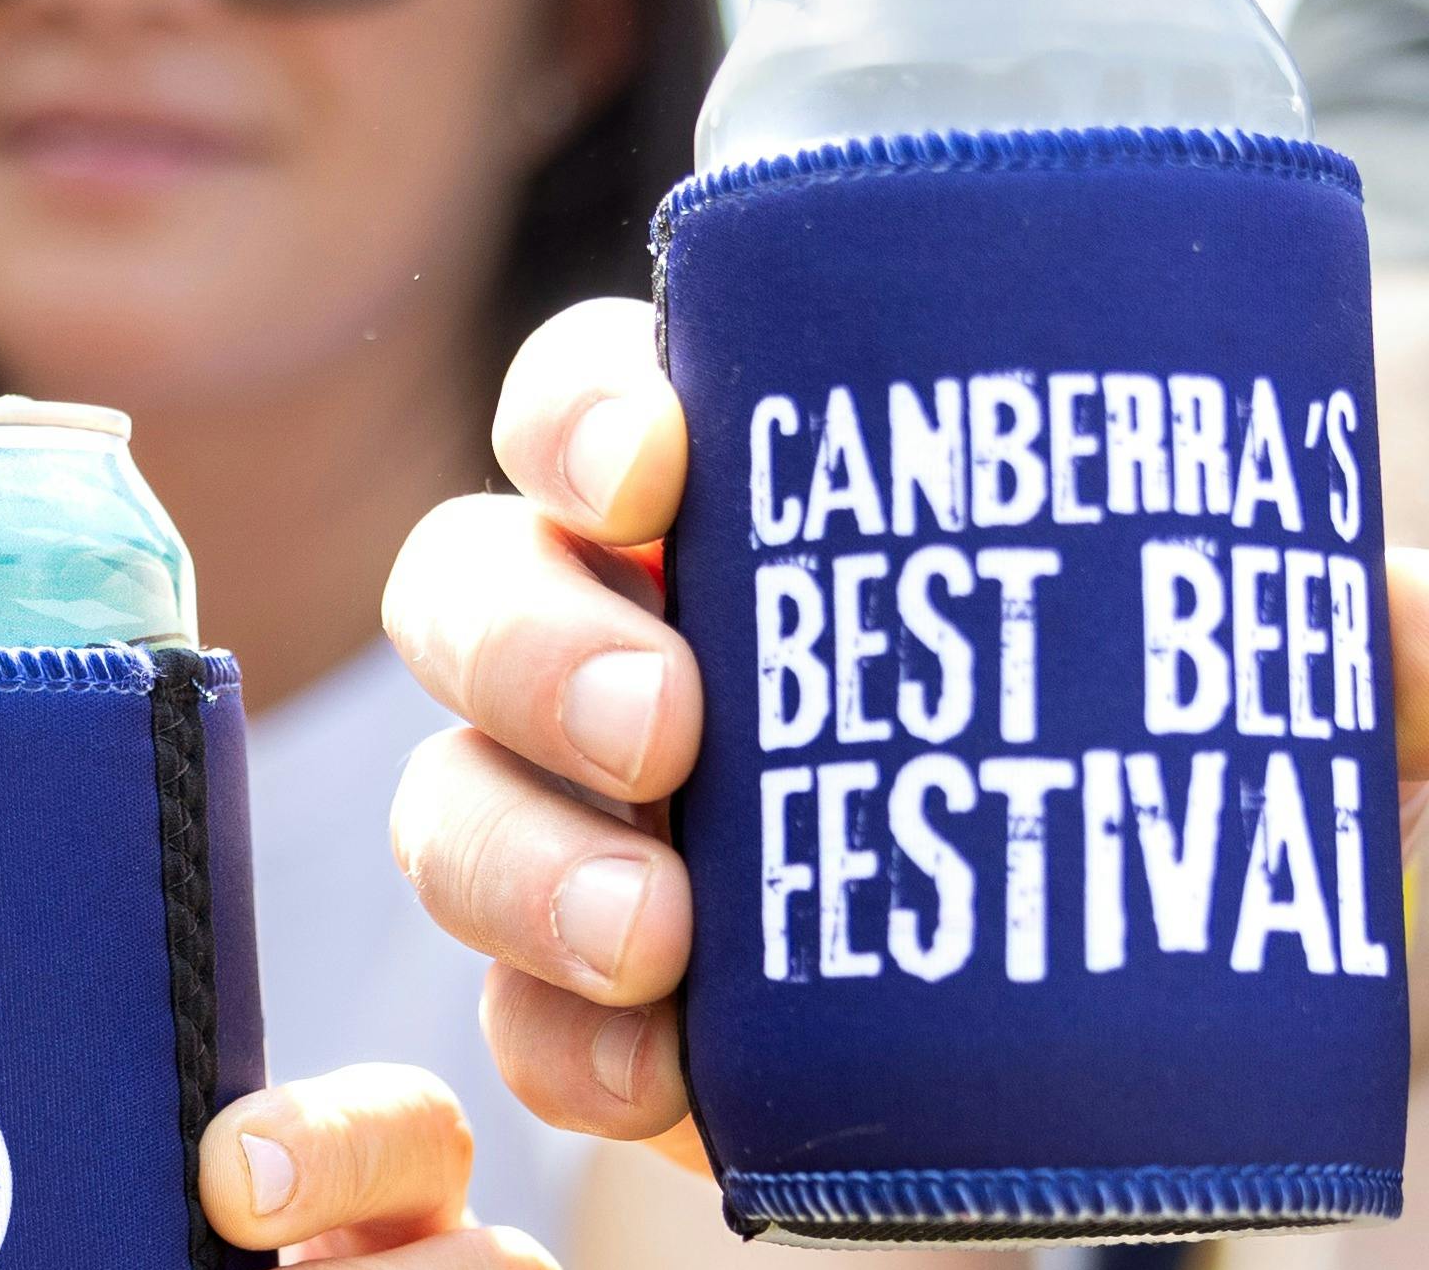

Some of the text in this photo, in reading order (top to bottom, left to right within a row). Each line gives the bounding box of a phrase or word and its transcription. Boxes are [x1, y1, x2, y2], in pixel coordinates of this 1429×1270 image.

[749, 369, 1361, 549] CANBERRA'S
[755, 535, 1375, 753] BEST BEER
[760, 749, 1389, 984] FESTIVAL
